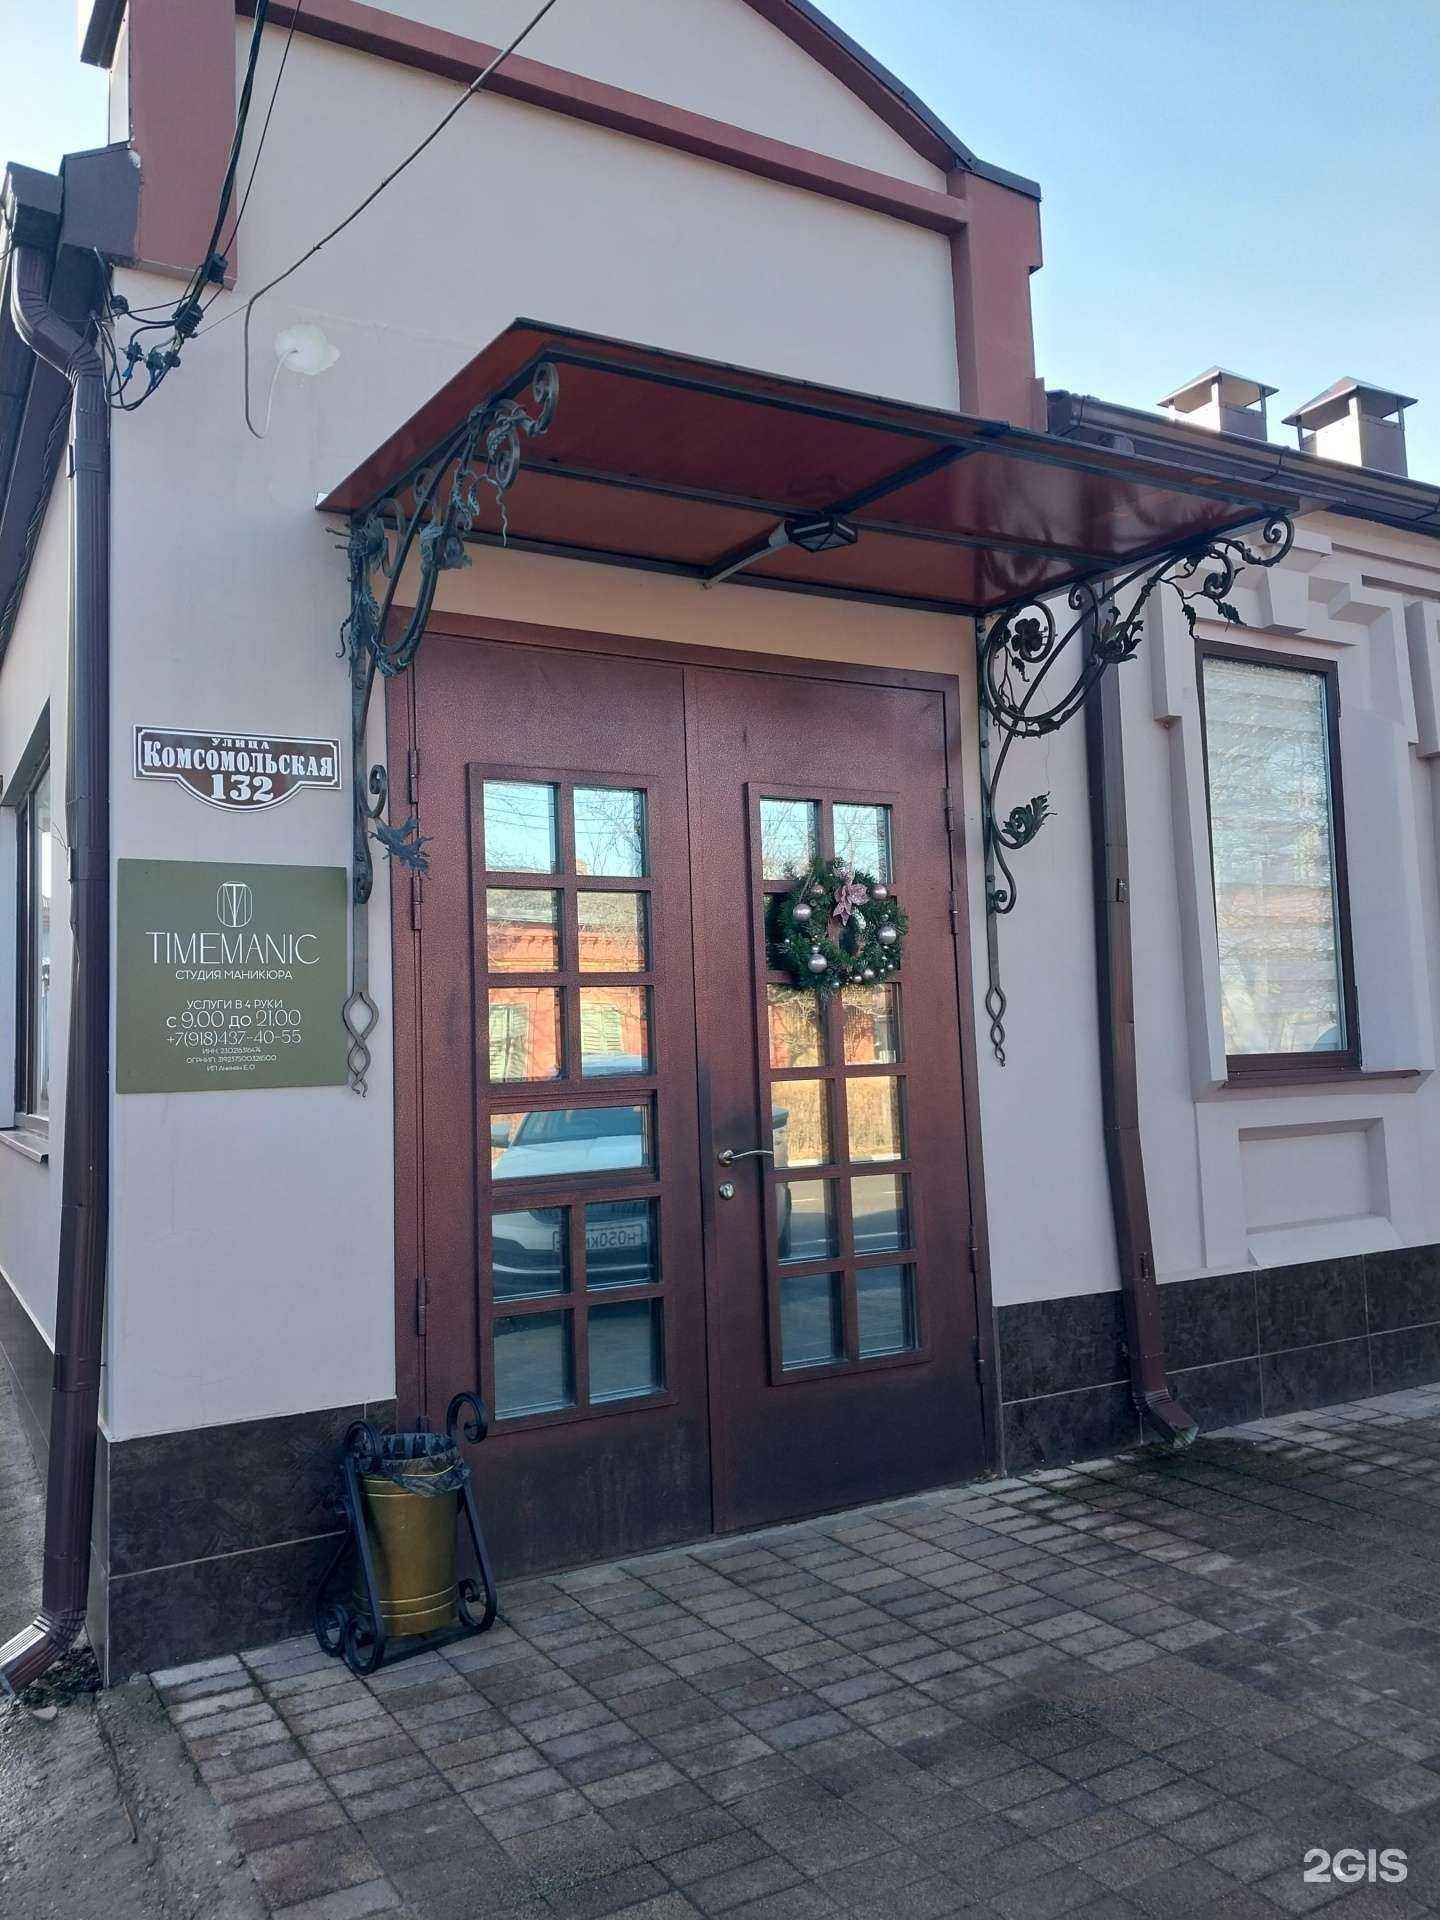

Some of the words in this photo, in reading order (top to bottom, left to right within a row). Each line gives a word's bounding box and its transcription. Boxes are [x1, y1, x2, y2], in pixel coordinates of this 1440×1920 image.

[212, 737, 270, 750] УЛИЦА
[210, 773, 274, 802] 132
[145, 932, 320, 965] TIMEMANIC
[175, 969, 222, 981] СТУДИЯ
[224, 969, 293, 981] МАНИКЮРА
[186, 999, 232, 1010] УСЛУГИ
[235, 999, 243, 1009] В
[244, 1000, 251, 1009] 4
[254, 999, 283, 1009] РУКИ
[181, 1010, 225, 1029] 9.00
[228, 1015, 252, 1029] до
